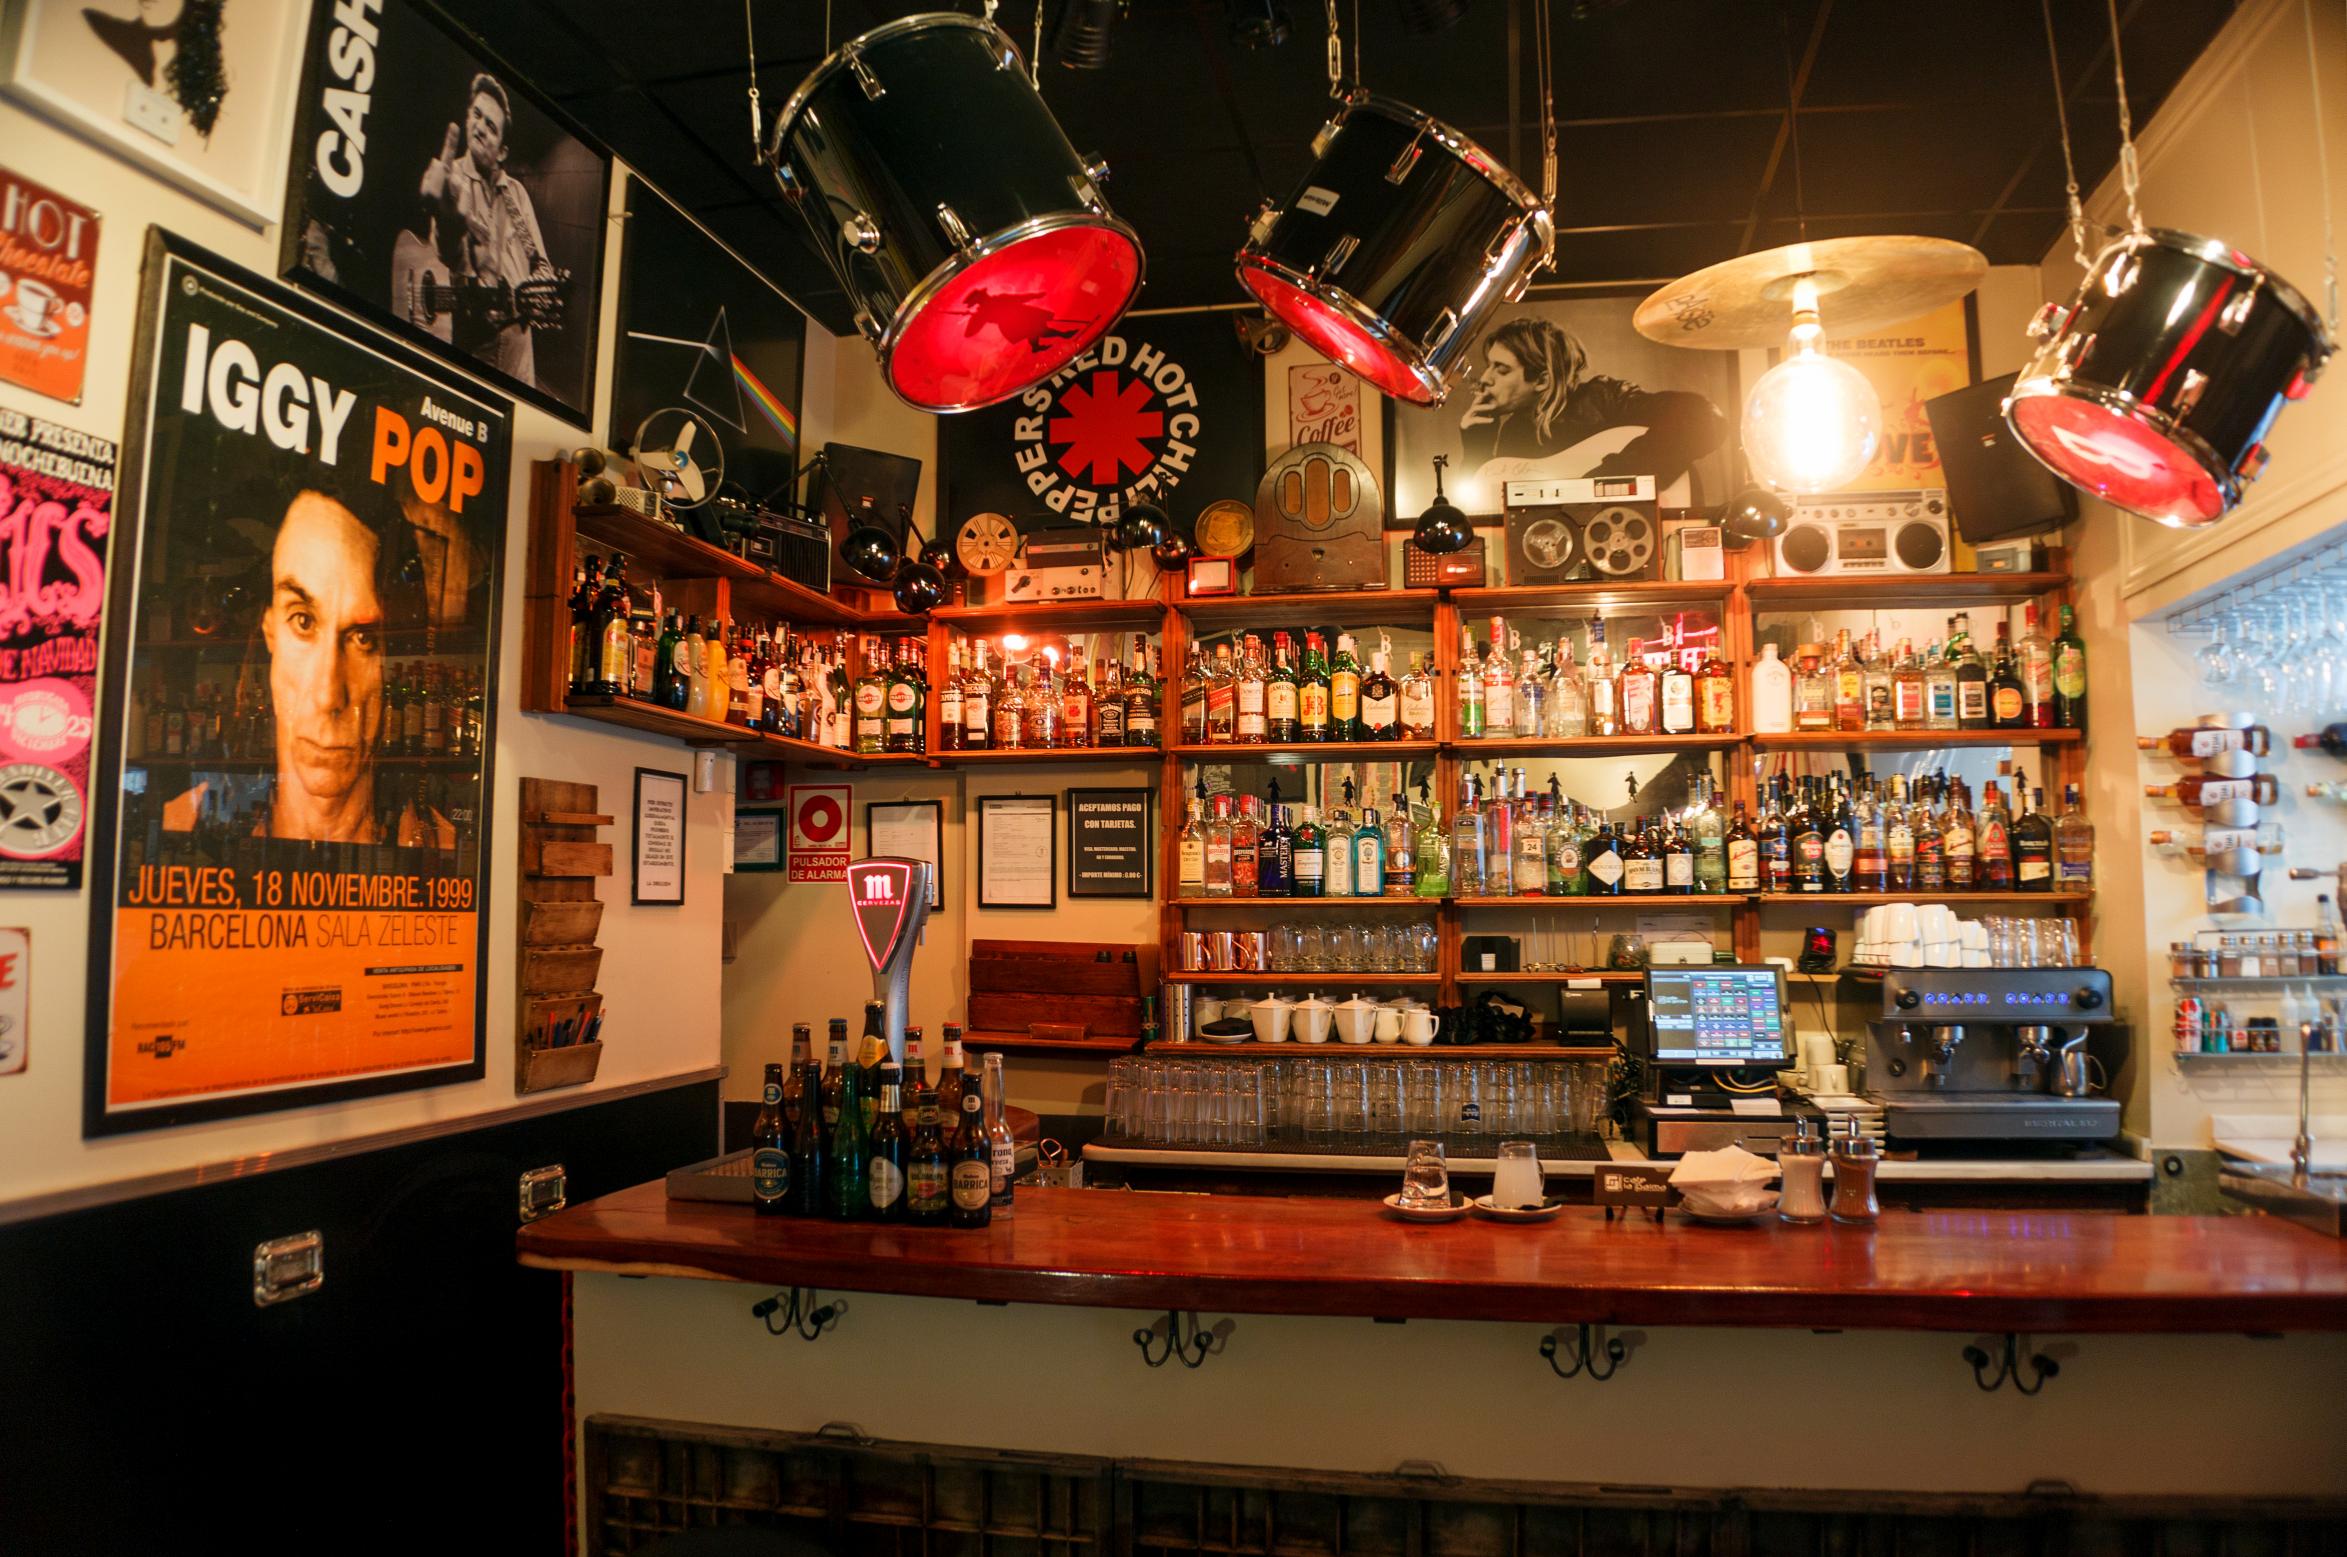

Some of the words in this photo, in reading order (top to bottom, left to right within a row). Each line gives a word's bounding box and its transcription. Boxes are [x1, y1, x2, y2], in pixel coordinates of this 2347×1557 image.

[315, 0, 385, 198] CASH
[2, 183, 88, 259] HOT
[1856, 337, 1926, 349] BEATLES
[181, 322, 358, 466] IGGY
[1129, 342, 1199, 409] HOT
[420, 396, 474, 437] Avenue
[478, 420, 489, 443] B
[1296, 416, 1357, 445] Coffee
[370, 405, 485, 514] POP
[20, 635, 98, 679] NAVIDAD
[1079, 803, 1121, 812] ACEPTAMOS
[1122, 803, 1142, 812] PAGO
[1084, 820, 1100, 829] CON
[1101, 820, 1136, 829] TARJETAS.
[793, 857, 847, 867] PULSADOR
[1527, 843, 1538, 851] 24
[128, 864, 243, 911] JUEVES,
[251, 870, 283, 906] 18
[791, 870, 805, 880] DE
[806, 870, 848, 880] ALARMA
[149, 913, 308, 950] BARCELONA
[315, 914, 373, 948] SALA
[377, 914, 459, 947] ZELESTE
[953, 1178, 988, 1190] BARRICA
